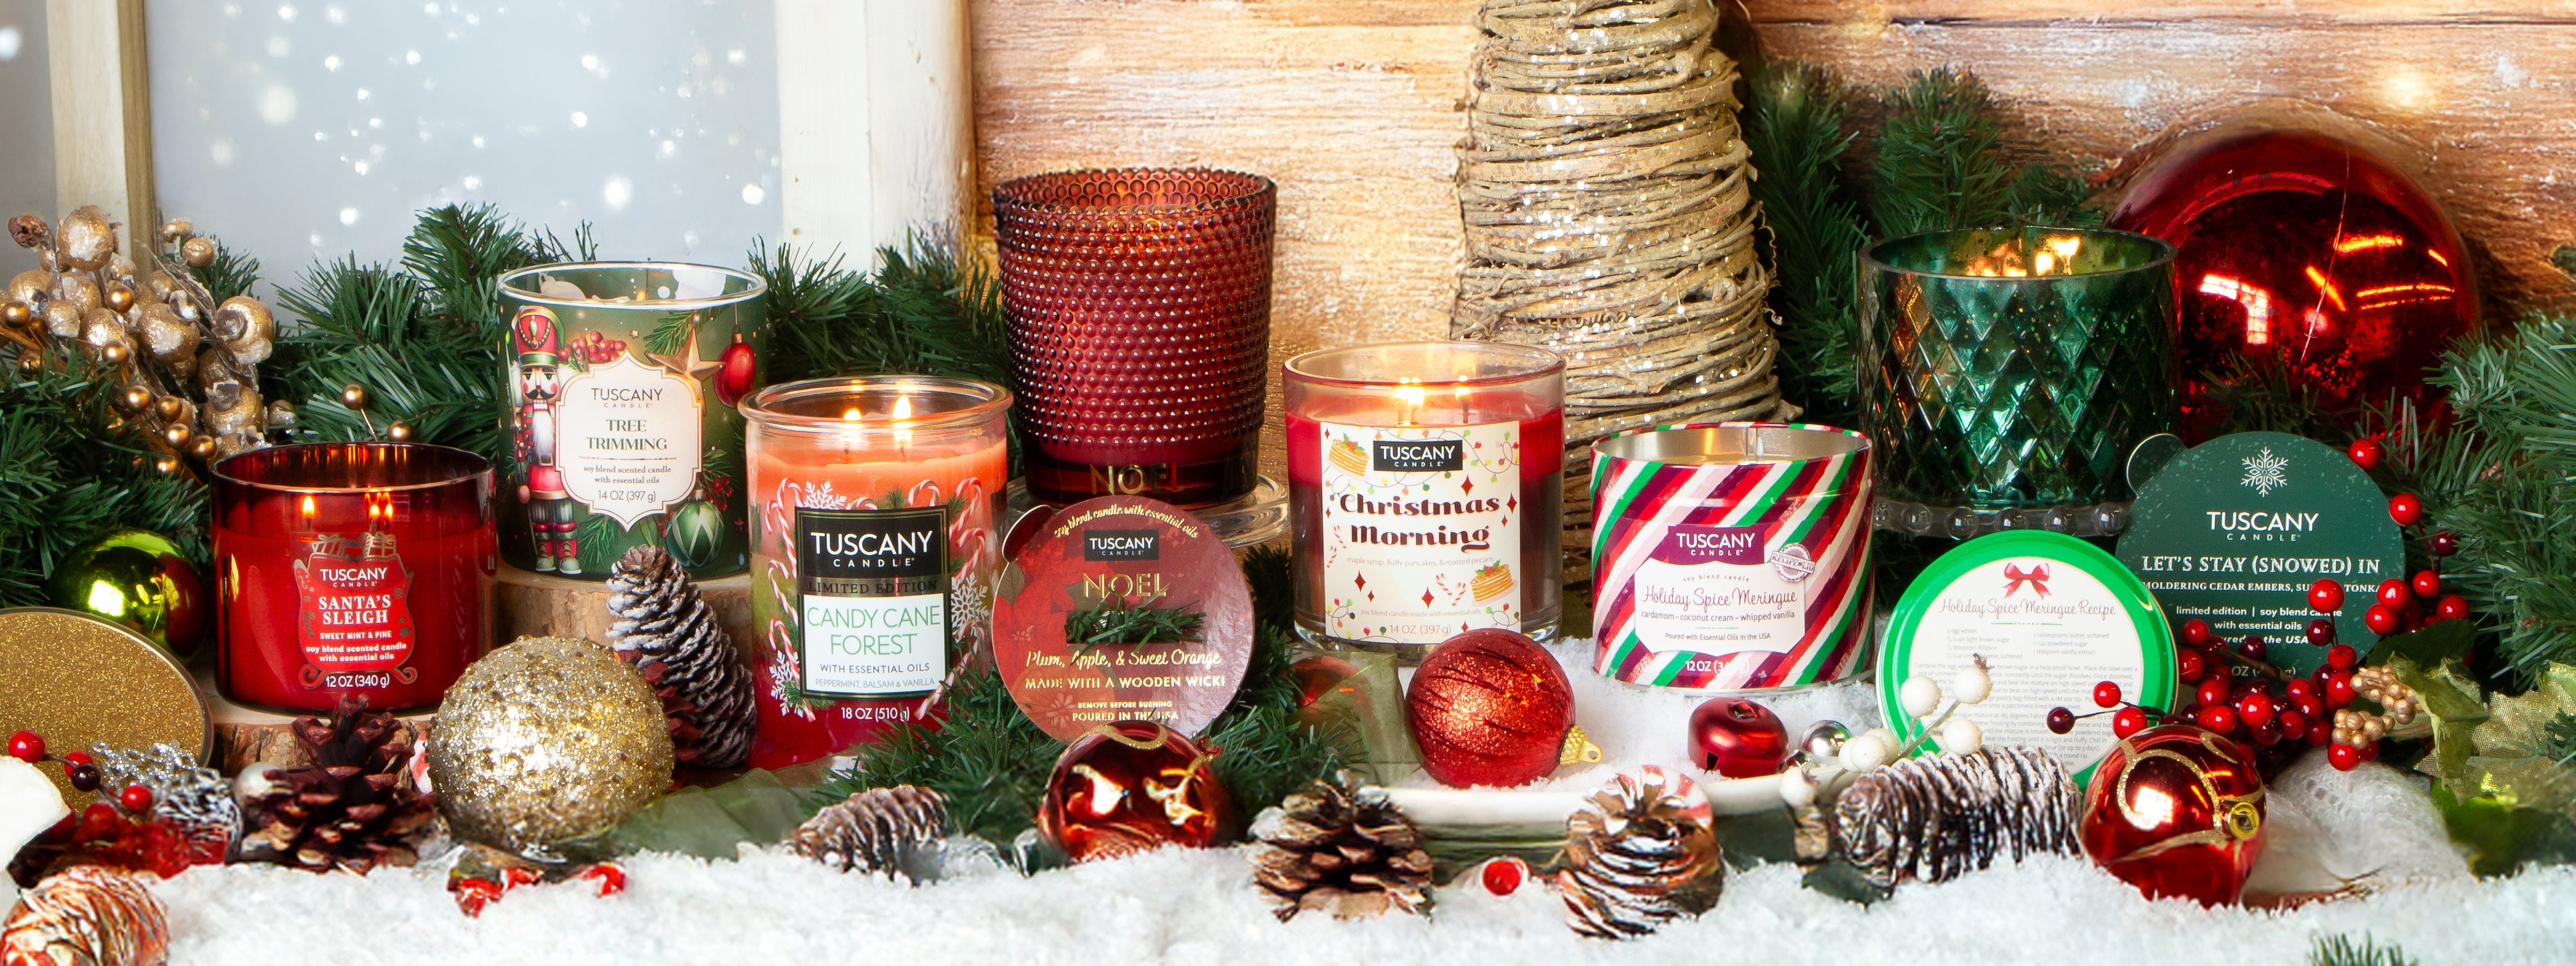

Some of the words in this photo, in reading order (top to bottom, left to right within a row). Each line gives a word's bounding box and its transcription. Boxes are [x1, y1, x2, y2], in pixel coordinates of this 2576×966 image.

[591, 388, 662, 401] TUSCANY
[606, 420, 646, 432] TREE
[586, 437, 667, 450] TRIMMING
[1381, 446, 1455, 460] TUSCANY
[599, 490, 607, 500] 14
[610, 491, 624, 500] OZ
[627, 491, 645, 501] (397
[647, 491, 656, 503] g)
[1340, 494, 1499, 516] Christmas
[1093, 504, 1123, 519] candle
[1124, 505, 1144, 515] with
[1145, 509, 1184, 529] essential
[1182, 524, 1198, 538] oils
[2207, 511, 2318, 531] TUSCANY
[810, 531, 932, 556] TUSCANY
[1090, 538, 1154, 550] TUSCANY
[1351, 525, 1490, 553] Morning
[1676, 533, 1755, 548] TUSCANY
[1347, 557, 1365, 565] maple
[1387, 558, 1403, 566] fluffy
[1471, 556, 1494, 564] pecans
[1772, 553, 1798, 566] RECIPE
[2142, 556, 2192, 572] LET'S
[2199, 556, 2245, 573] STAY
[2252, 555, 2352, 575] (SNOWED)
[2358, 559, 2380, 574] IN
[320, 568, 387, 581] TUSCANY
[808, 581, 868, 594] LIMITED
[876, 580, 937, 594] EDITION
[1084, 573, 1166, 598] NOEL
[2143, 581, 2207, 590] MOLDERING
[2209, 583, 2246, 591] CEDAR
[2248, 583, 2293, 593] EMBERS,
[319, 595, 390, 610] SANTA'S
[1642, 585, 1690, 612] Holiday
[1693, 588, 1730, 613] Spice
[1732, 587, 1797, 612] Meringue
[1937, 598, 1985, 618] Holiday
[1987, 598, 2019, 619] Spice
[2020, 599, 2077, 619] Meringue
[2079, 600, 2116, 621] Recipe
[2176, 607, 2211, 615] limited
[2212, 607, 2247, 616] edition
[2260, 608, 2276, 618] soy
[2280, 608, 2307, 617] blend
[323, 610, 388, 625] SLEIGH
[807, 607, 878, 628] CANDY
[883, 605, 941, 627] CANE
[1641, 610, 1674, 619] cardamom
[1680, 613, 1709, 622] coconut
[1740, 612, 1772, 623] whipped
[1773, 610, 1794, 619] vanilla
[1389, 625, 1399, 634] 14
[1401, 625, 1416, 634] OZ
[1420, 625, 1440, 635] (397
[1442, 625, 1451, 635] g)
[2214, 621, 2236, 629] with
[2238, 621, 2282, 630] essential
[2285, 622, 2302, 630] oils
[831, 634, 918, 655] FOREST
[2264, 635, 2281, 644] the
[2286, 635, 2308, 644] USA
[382, 642, 406, 651] candle
[1026, 650, 1065, 668] Plum,
[1116, 650, 1125, 666] &
[1128, 651, 1168, 666] Sweet
[1171, 649, 1222, 669] Orange
[820, 664, 845, 673] WITH
[849, 665, 903, 673] ESSENTIAL
[907, 663, 929, 672] OILS
[1685, 661, 1695, 672] 12
[1697, 661, 1712, 672] OZ
[326, 676, 336, 688] 12
[338, 676, 353, 687] OZ
[355, 674, 378, 687] (340
[380, 674, 389, 688] g)
[815, 679, 861, 688] PEPPERMINT,
[863, 679, 894, 688] BALSAM
[903, 678, 935, 687] VANILLA
[1025, 678, 1062, 689] MADE
[1068, 678, 1100, 688] WITH
[1105, 677, 1114, 687] A
[1119, 677, 1181, 688] WOODEN
[841, 707, 852, 719] 18
[854, 707, 872, 719] OZ
[875, 707, 898, 721] (510
[1072, 712, 1115, 721] POURED
[1119, 712, 1130, 721] IN
[1135, 712, 1153, 720] THE
